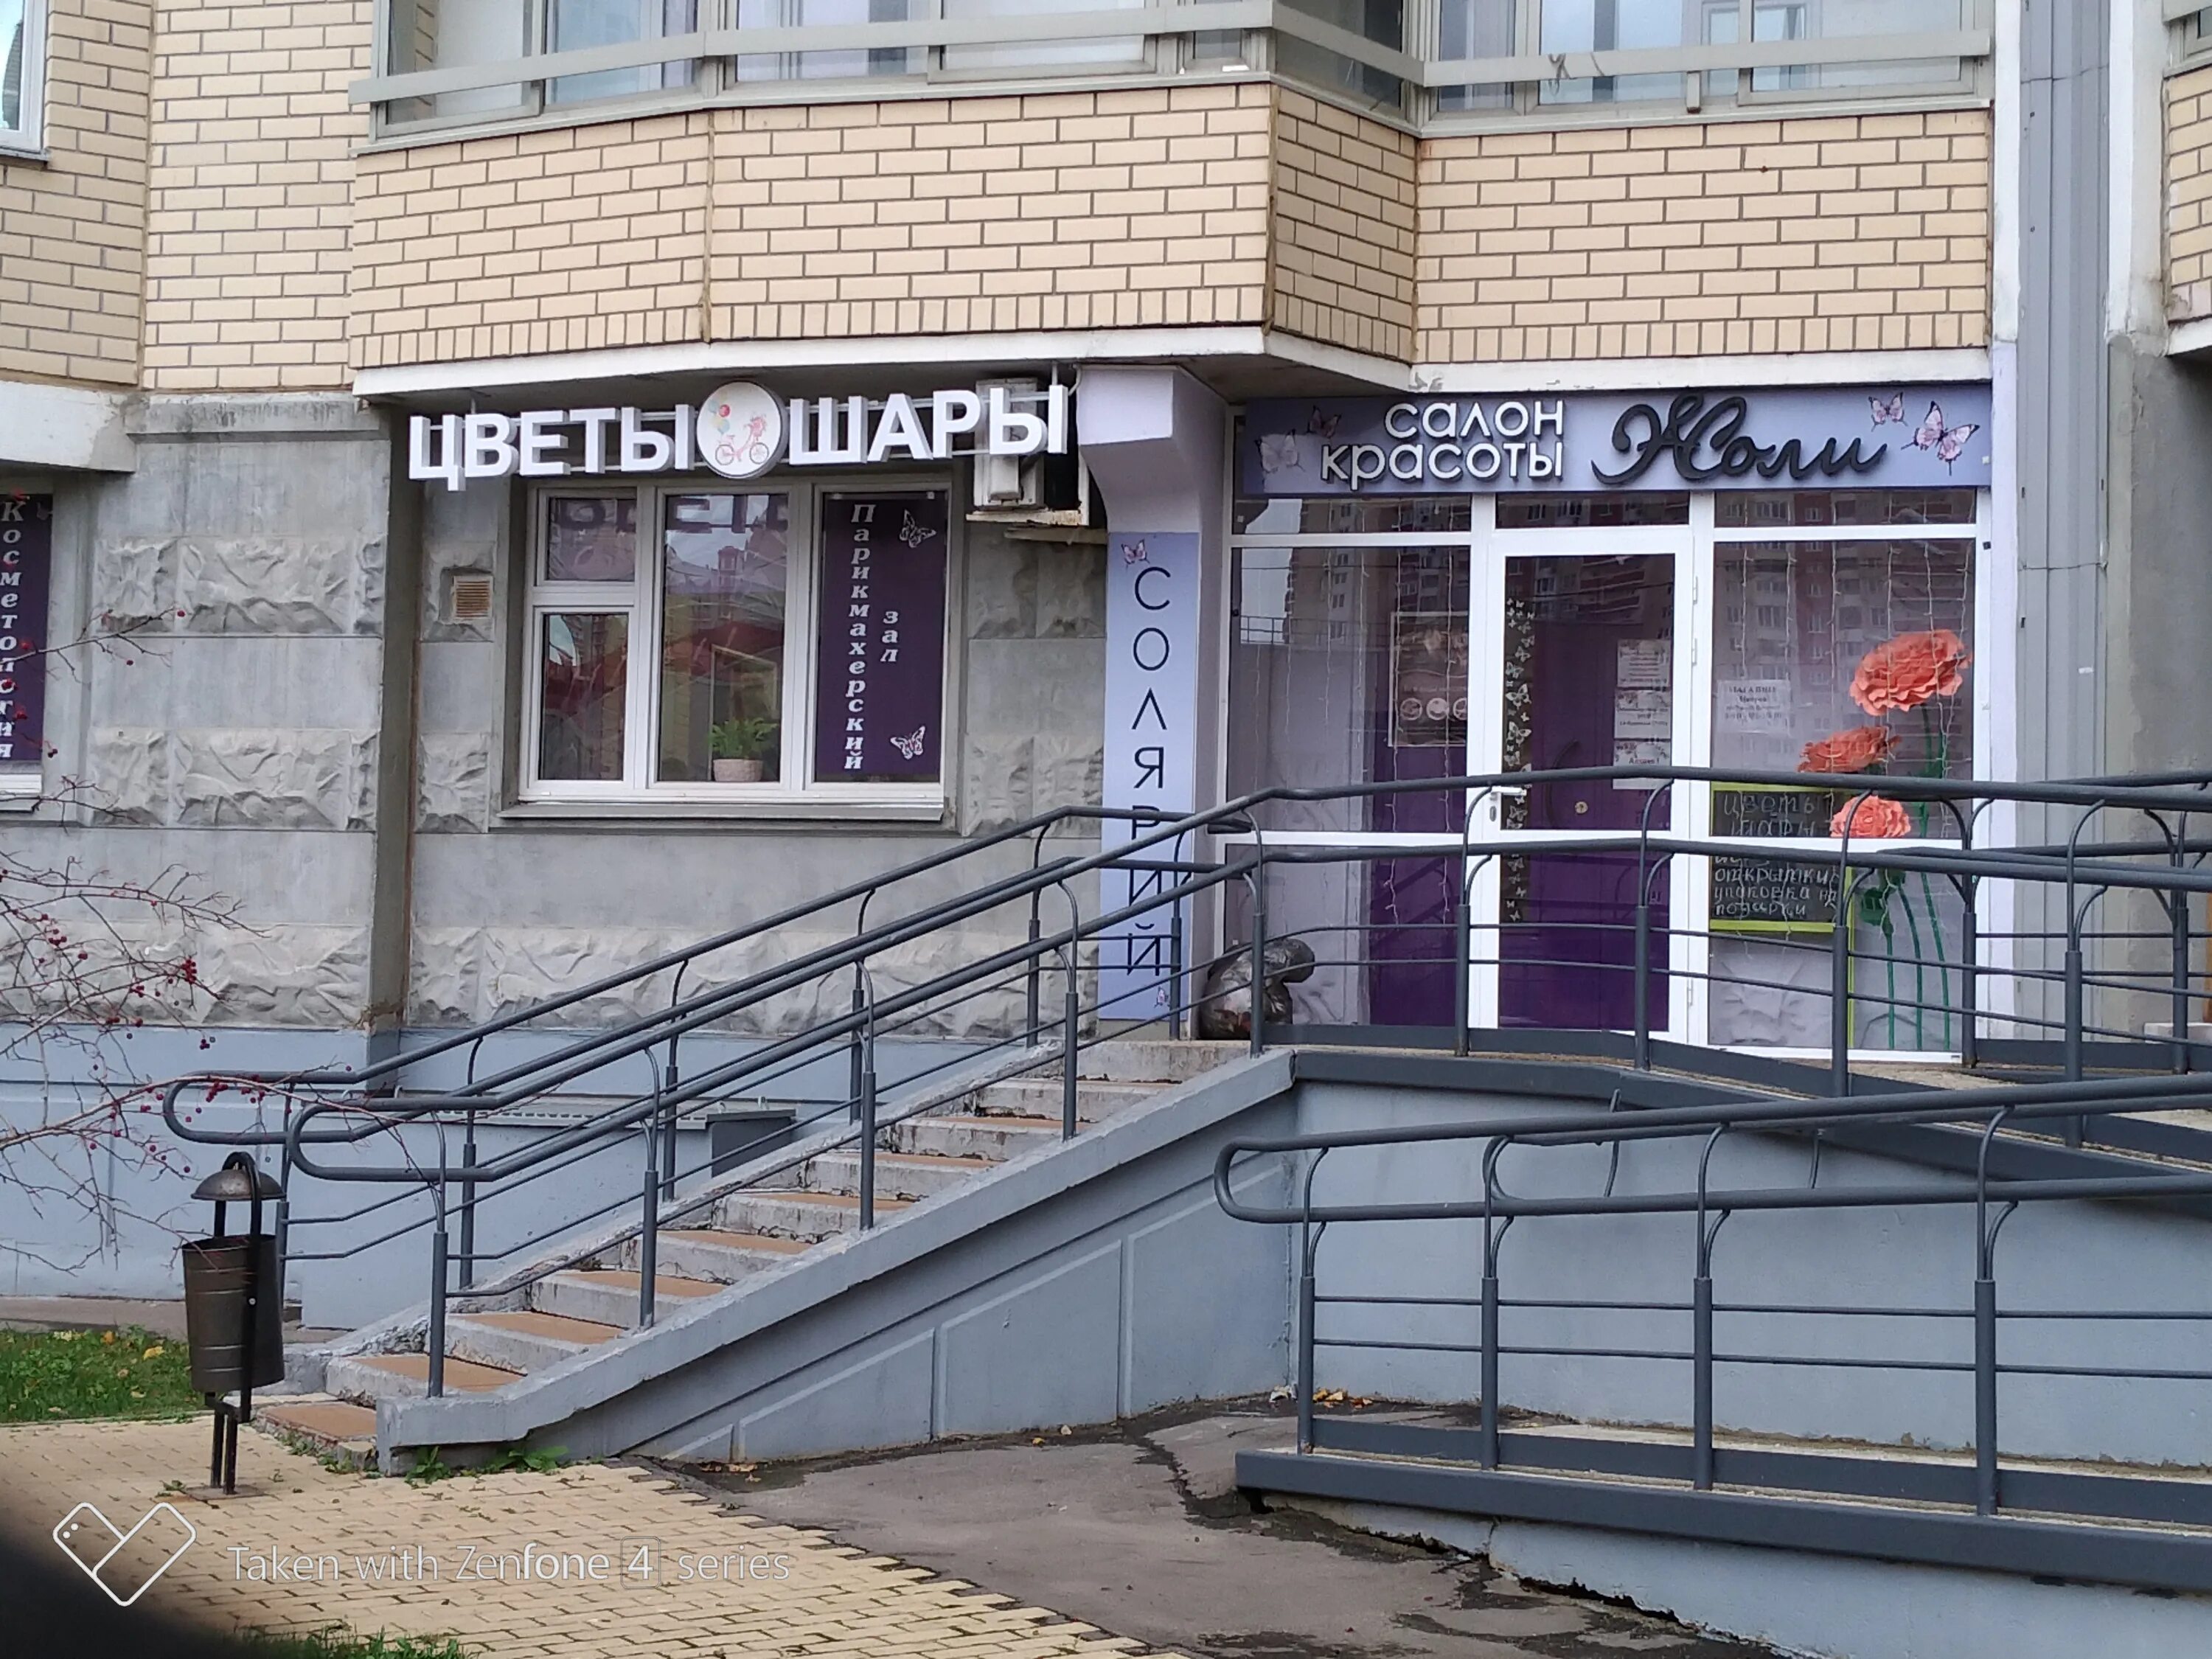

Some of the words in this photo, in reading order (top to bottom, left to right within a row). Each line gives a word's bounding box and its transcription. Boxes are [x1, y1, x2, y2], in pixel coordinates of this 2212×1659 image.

[408, 403, 698, 491] ЦВЕТЫ
[790, 384, 1068, 466] ШАРЫ
[1384, 400, 1564, 439] салон
[1321, 442, 1564, 491] красоты
[844, 504, 876, 770] Парикмахерский
[880, 611, 899, 662] зал
[1125, 566, 1172, 976] СОЛЯРИЙ
